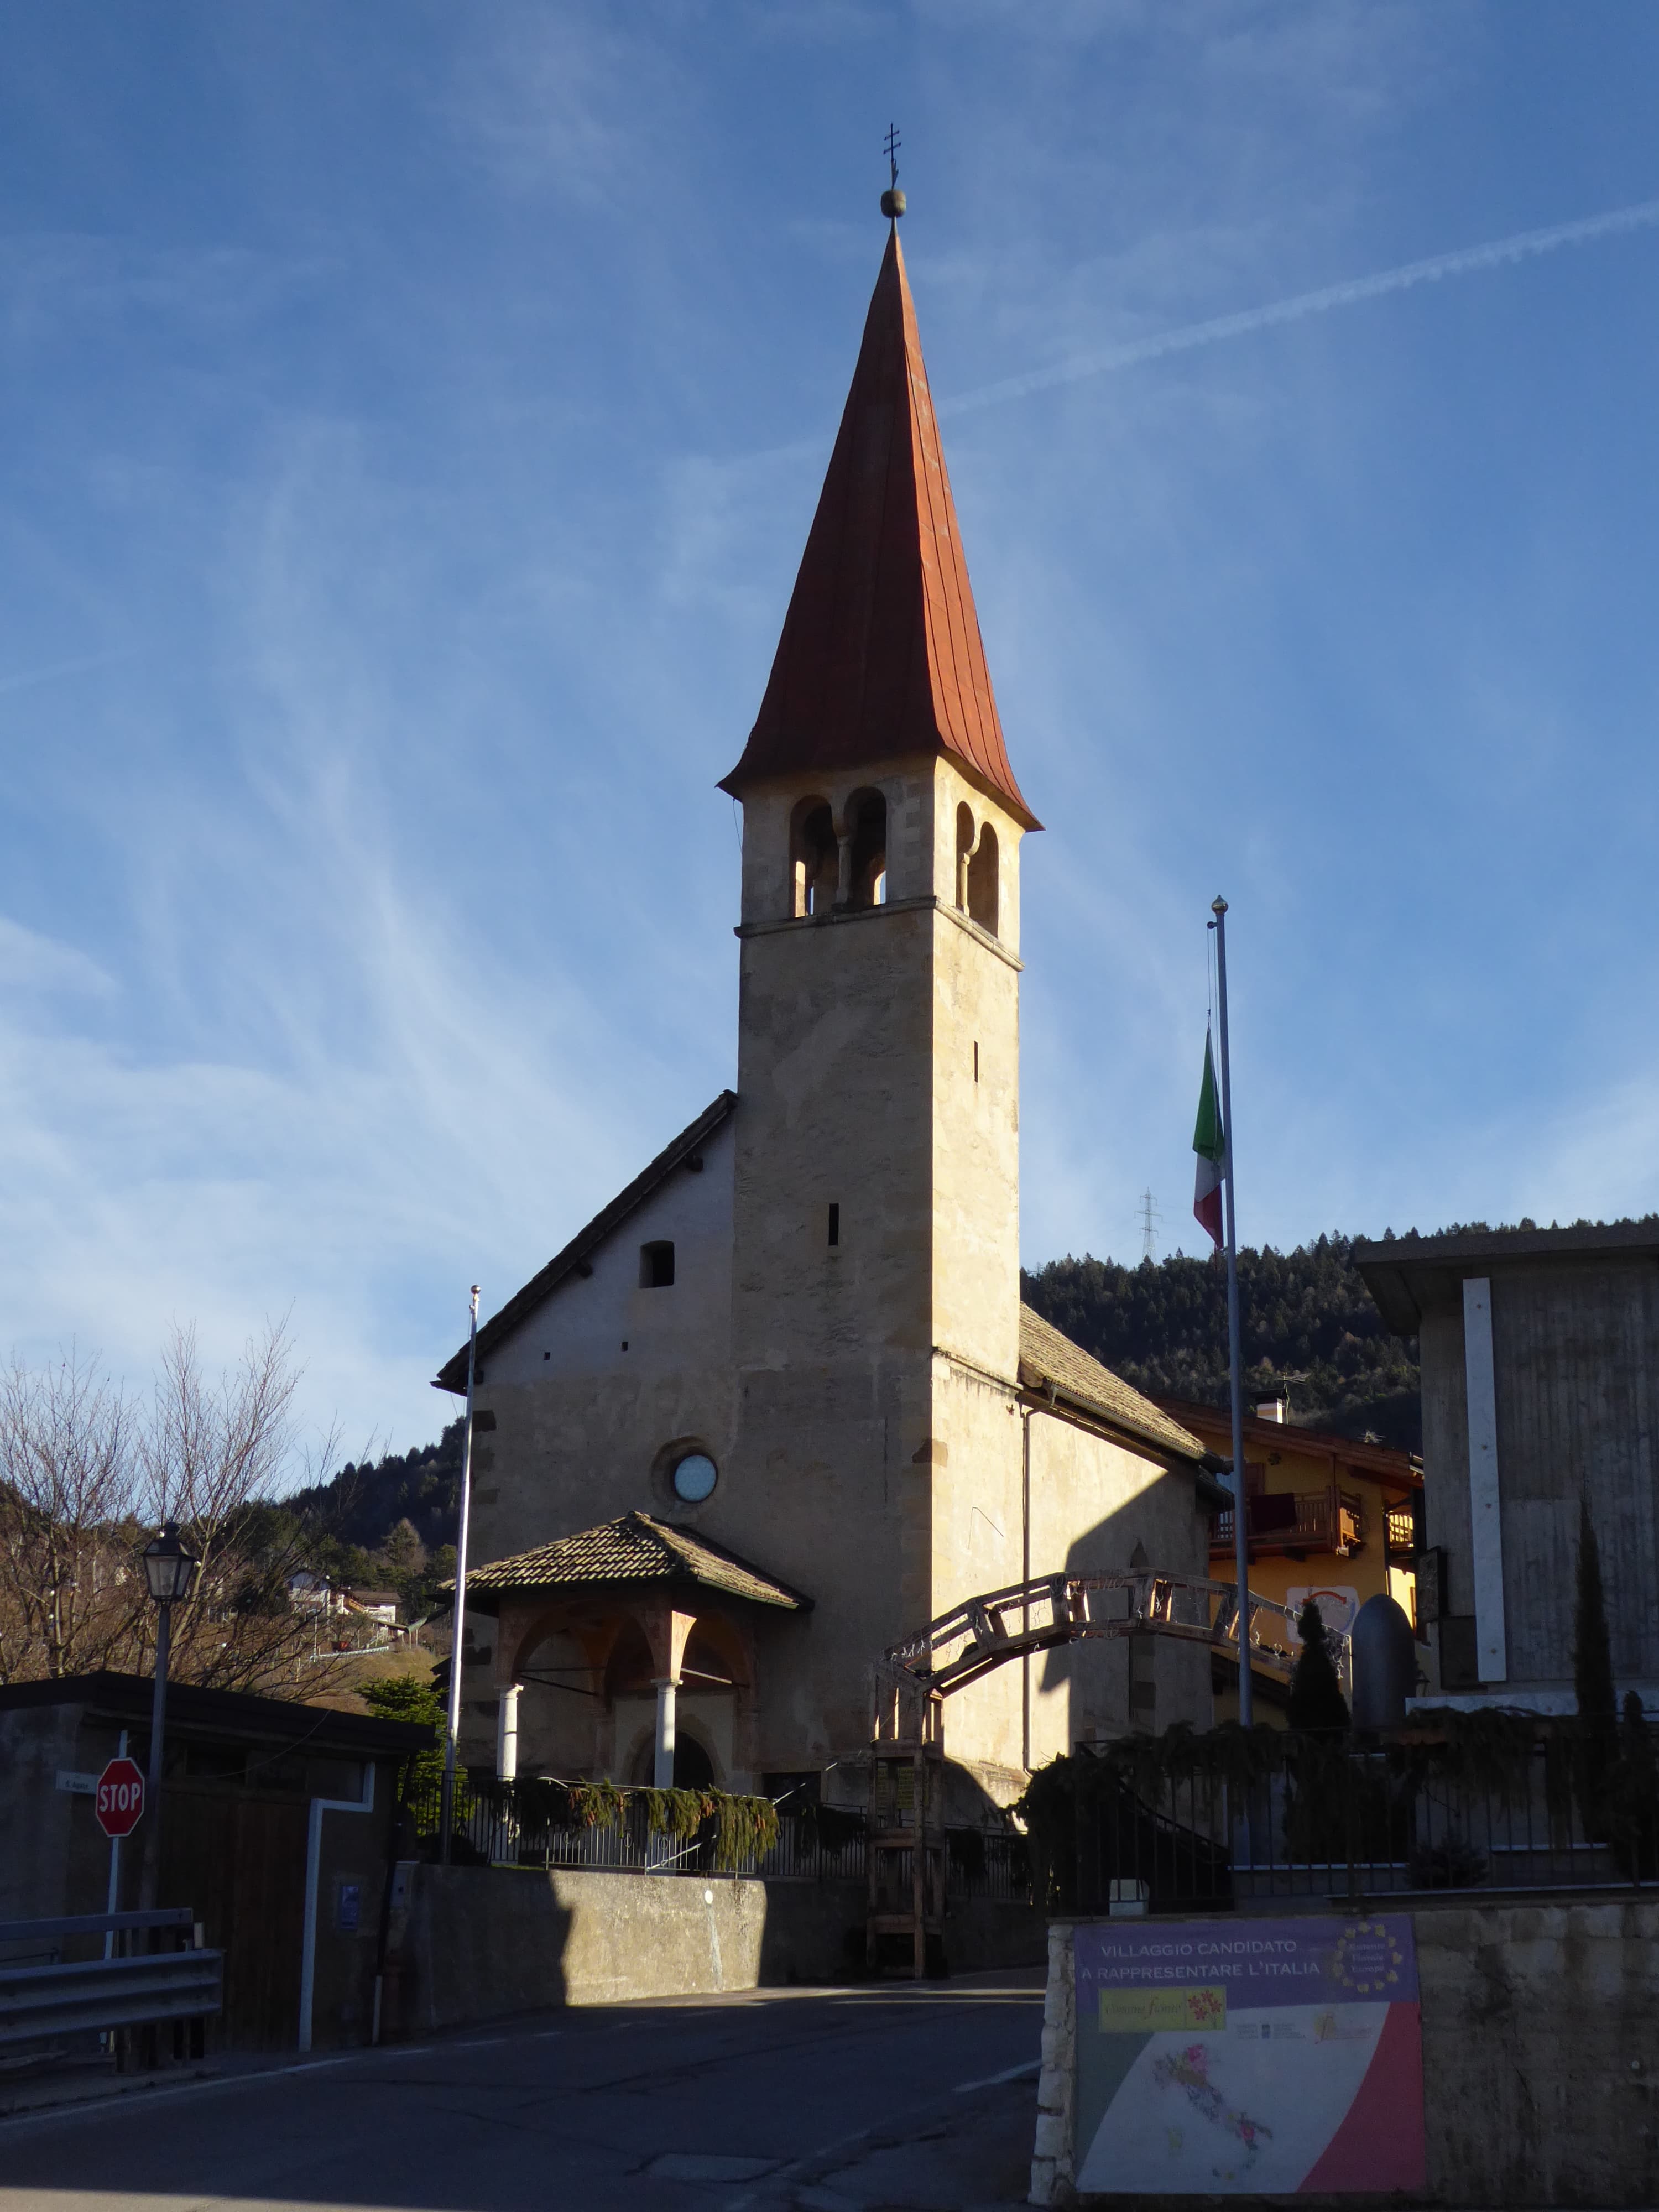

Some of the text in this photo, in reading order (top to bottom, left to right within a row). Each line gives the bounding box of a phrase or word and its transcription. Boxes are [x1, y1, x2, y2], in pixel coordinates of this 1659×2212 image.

[99, 1782, 141, 1813] STOP
[1101, 1940, 1297, 1958] VILLAGGIO CANDIDATO
[1082, 1961, 1321, 1980] A RAPPRESENTARE L'ITALIA
